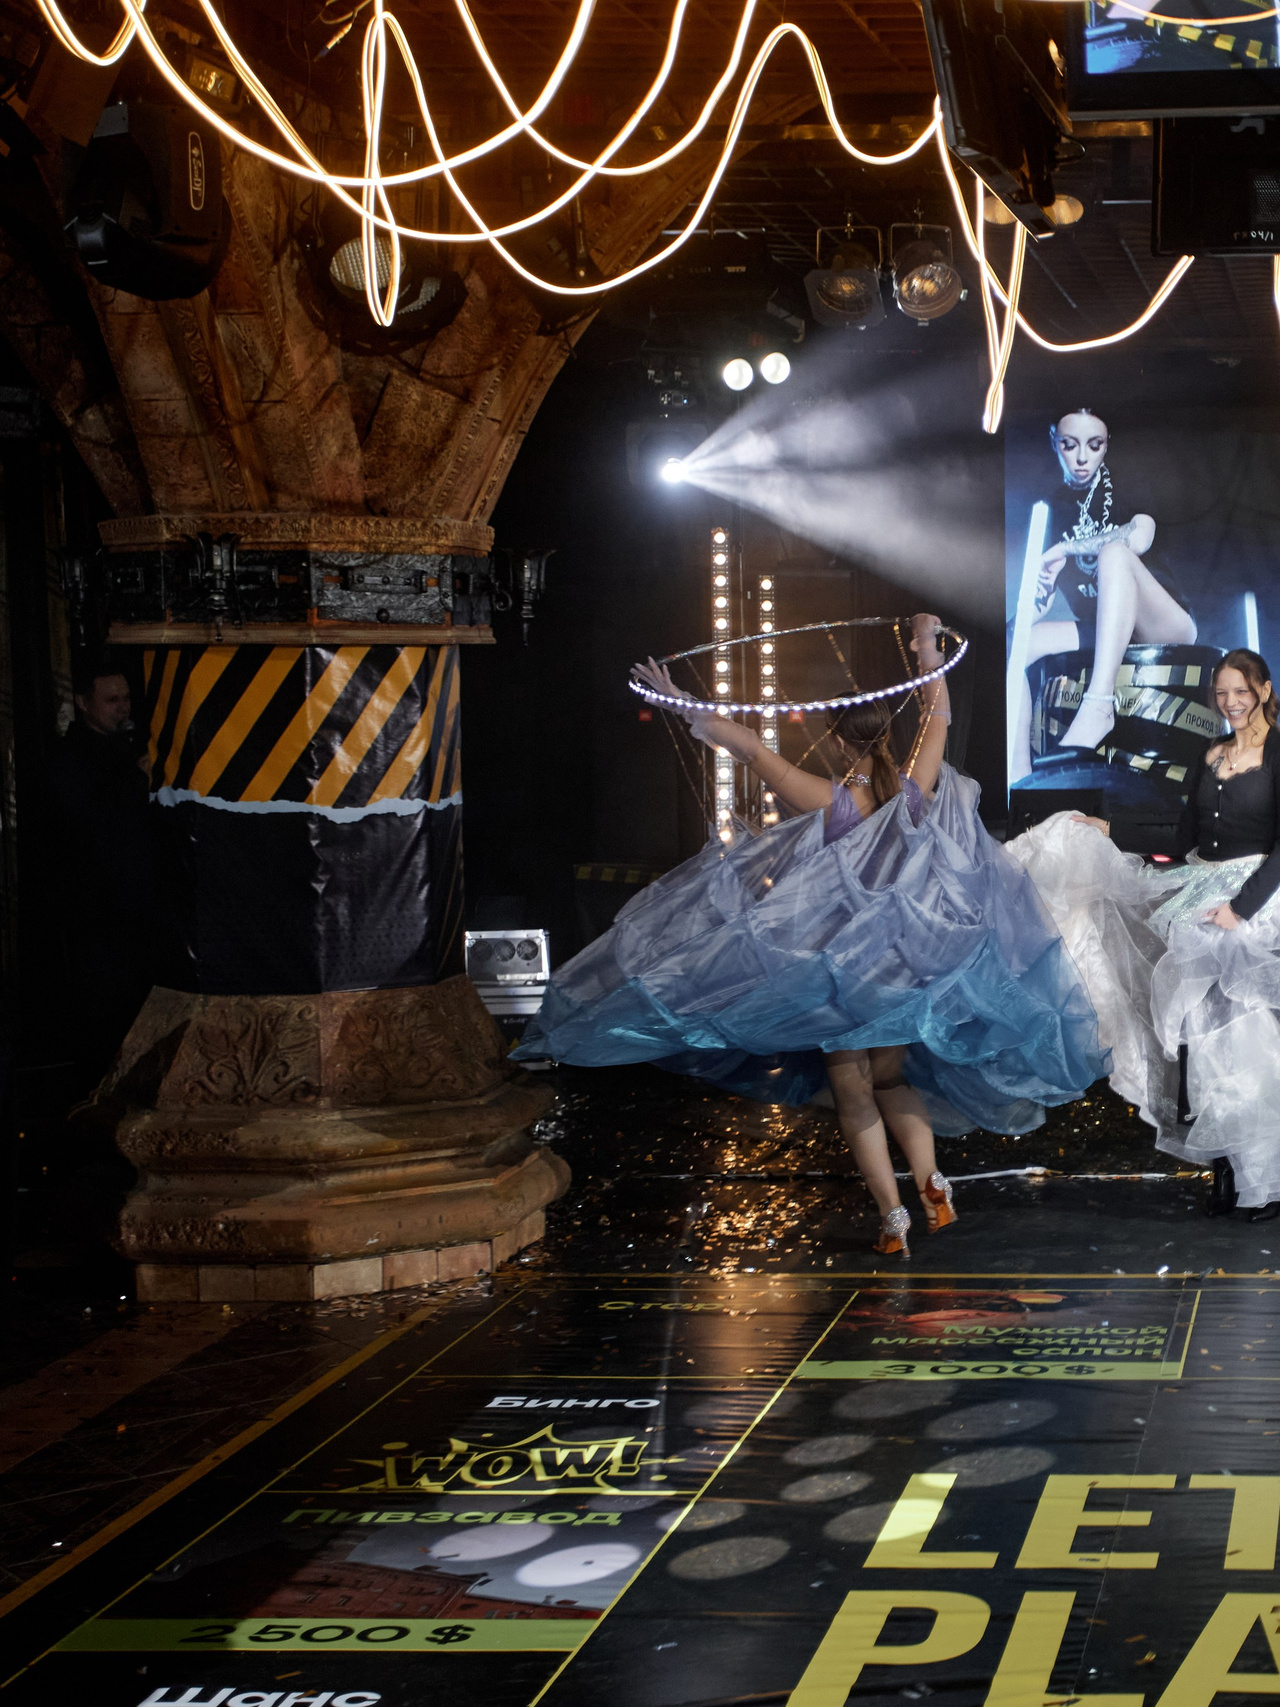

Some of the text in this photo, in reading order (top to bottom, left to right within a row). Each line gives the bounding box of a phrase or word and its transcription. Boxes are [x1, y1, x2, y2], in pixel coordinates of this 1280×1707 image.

[943, 1325, 1168, 1337] Мужской
[871, 1336, 1165, 1346] массажный
[1012, 1347, 1163, 1357] салон
[485, 1396, 661, 1409] Бинго
[386, 1441, 649, 1489] WOW!
[282, 1508, 622, 1527] Пивзавод
[135, 1687, 382, 1707] Шанс
